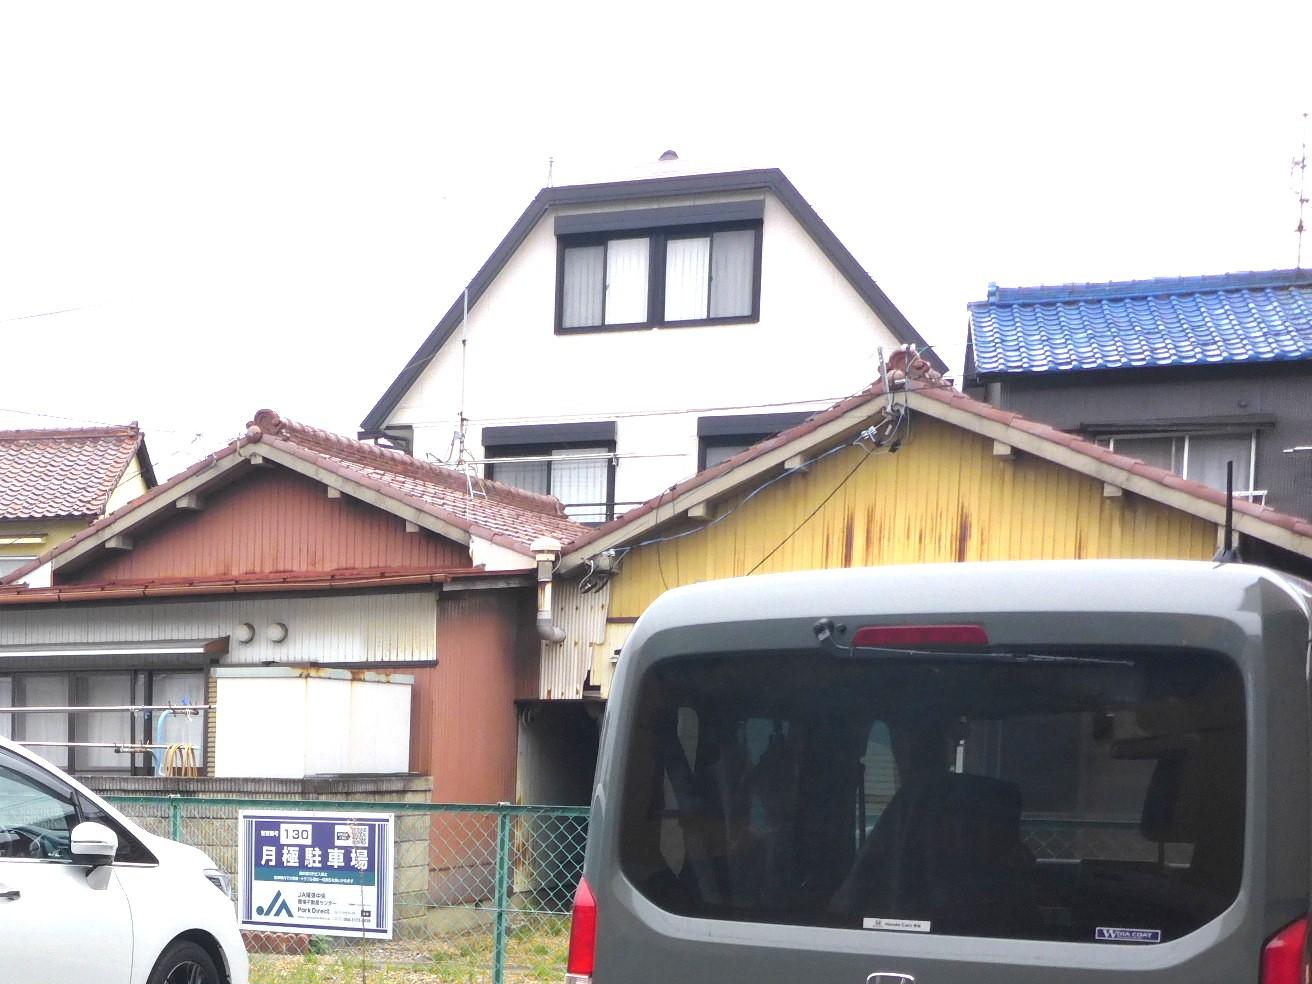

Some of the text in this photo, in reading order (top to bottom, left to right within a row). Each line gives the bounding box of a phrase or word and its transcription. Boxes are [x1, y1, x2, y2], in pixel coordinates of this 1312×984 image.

[284, 829, 309, 840] 130
[261, 846, 368, 870] 月極駐車場
